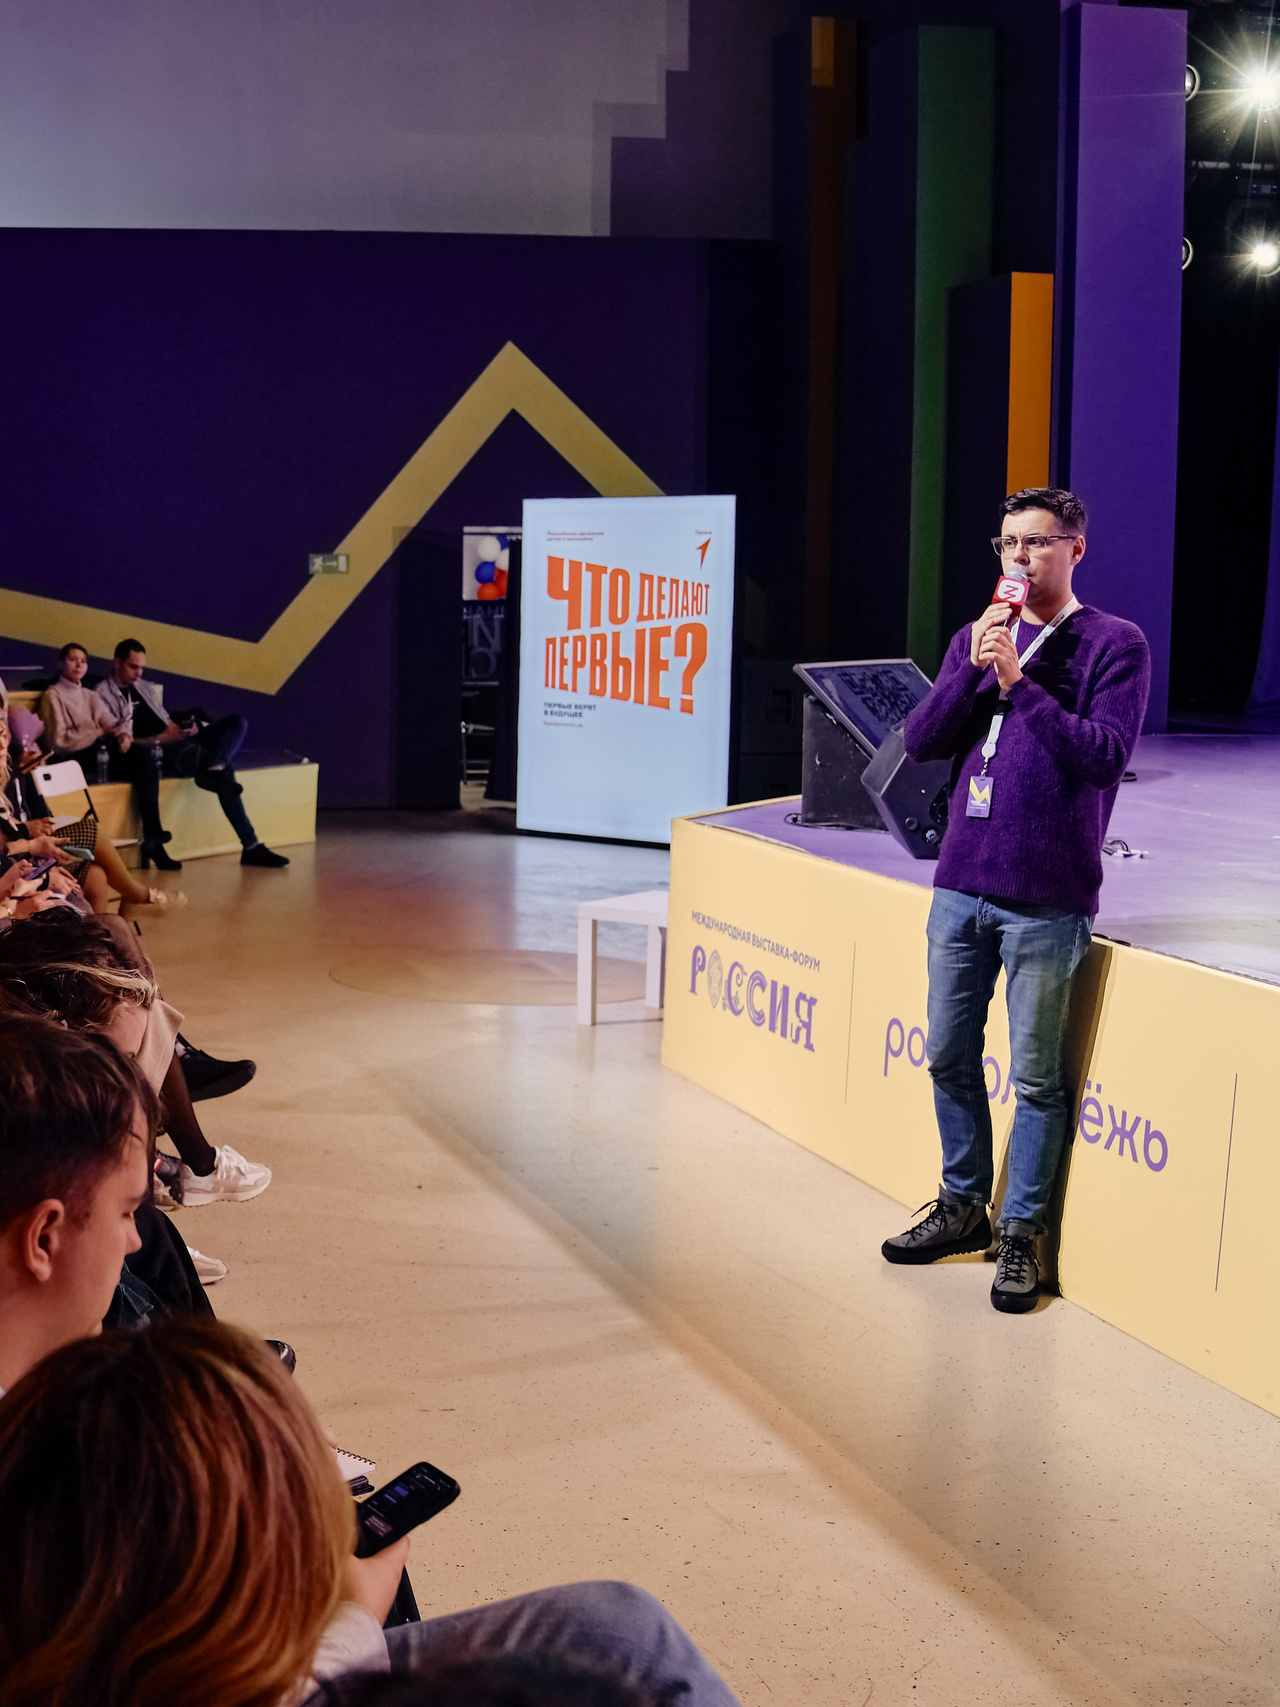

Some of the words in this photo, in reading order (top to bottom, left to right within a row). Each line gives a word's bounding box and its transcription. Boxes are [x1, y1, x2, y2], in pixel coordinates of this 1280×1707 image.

[547, 555, 631, 631] ЧТО
[636, 572, 710, 623] ДЕЛАЮТ
[544, 622, 708, 715] ПЕРВЫЕ?
[691, 910, 751, 944] МЕЖДУНАРОДНАЯ
[751, 933, 821, 972] ВЫСТАВКА-ФОРУМ
[688, 945, 818, 1053] РОССИЯ
